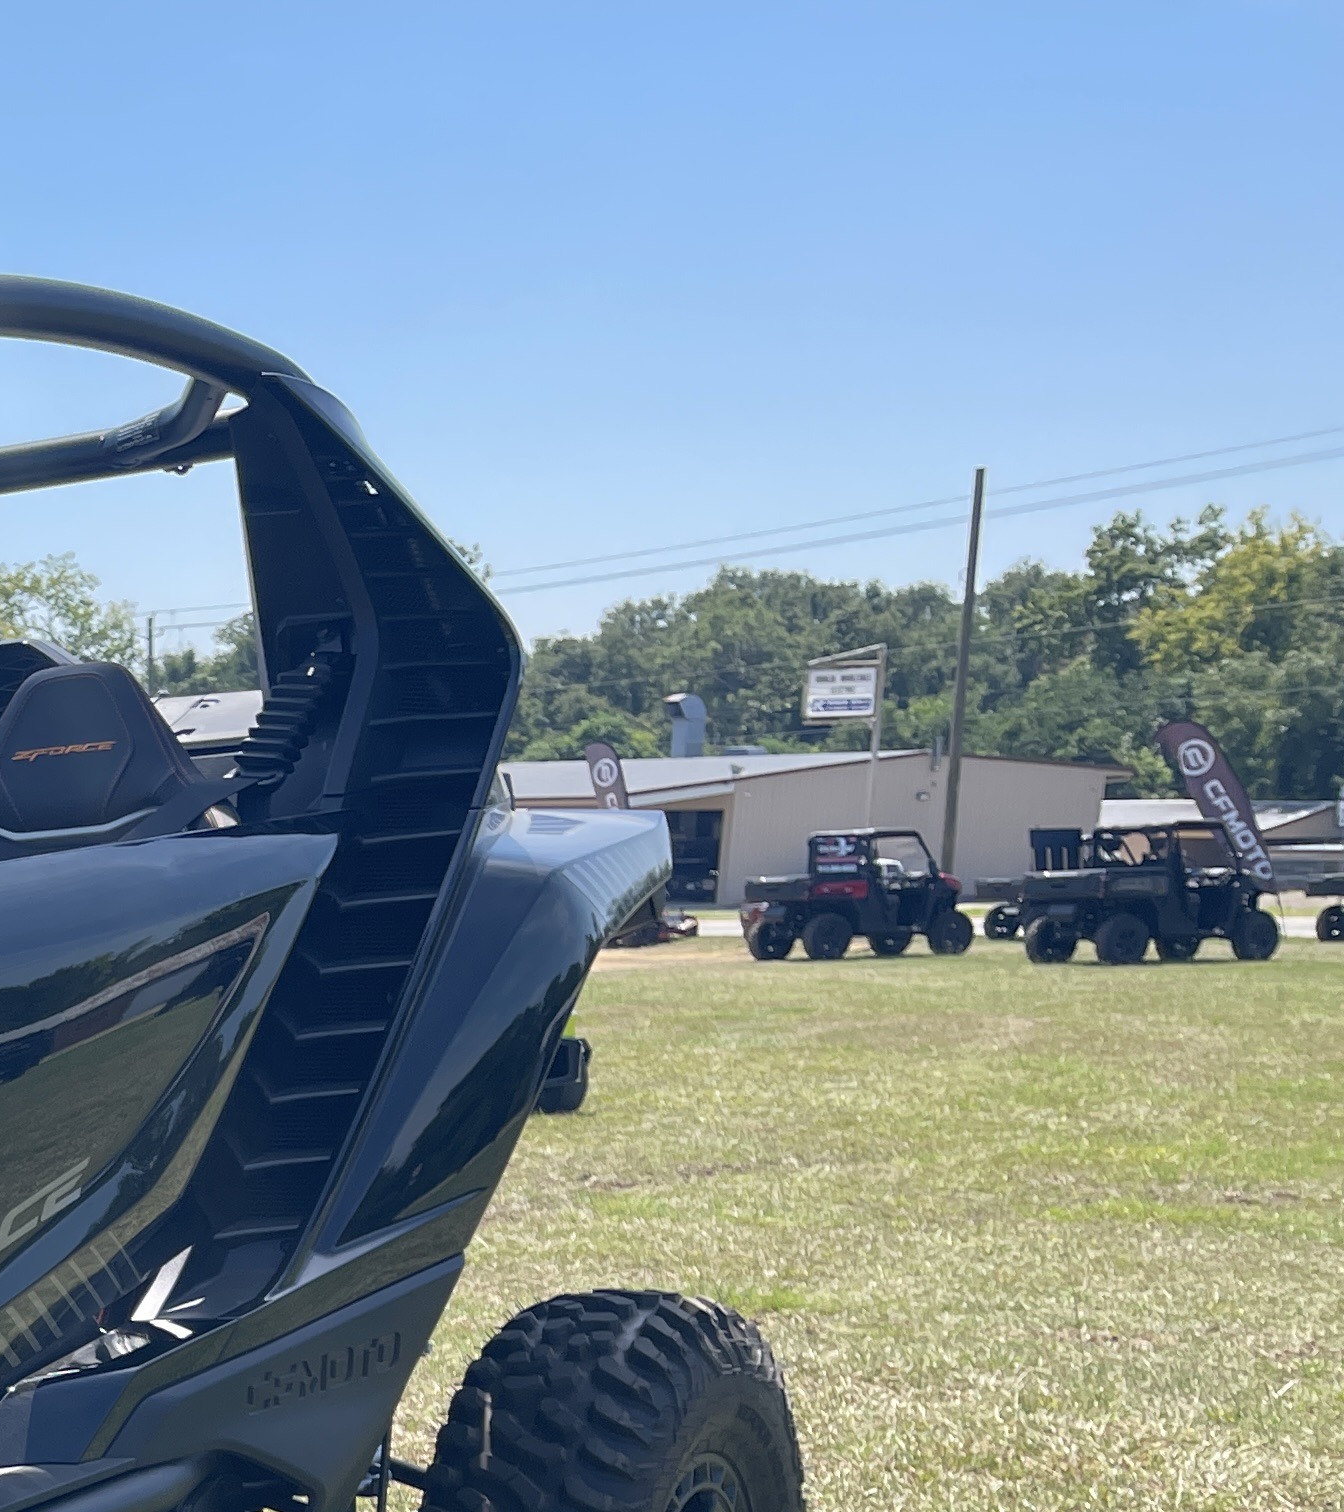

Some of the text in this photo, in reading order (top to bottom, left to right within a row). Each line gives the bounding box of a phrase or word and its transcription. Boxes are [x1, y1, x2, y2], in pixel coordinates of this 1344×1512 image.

[11, 740, 117, 762] ZFORCE
[1202, 778, 1273, 881] CFMOTO
[246, 1331, 402, 1416] CFMOTO
